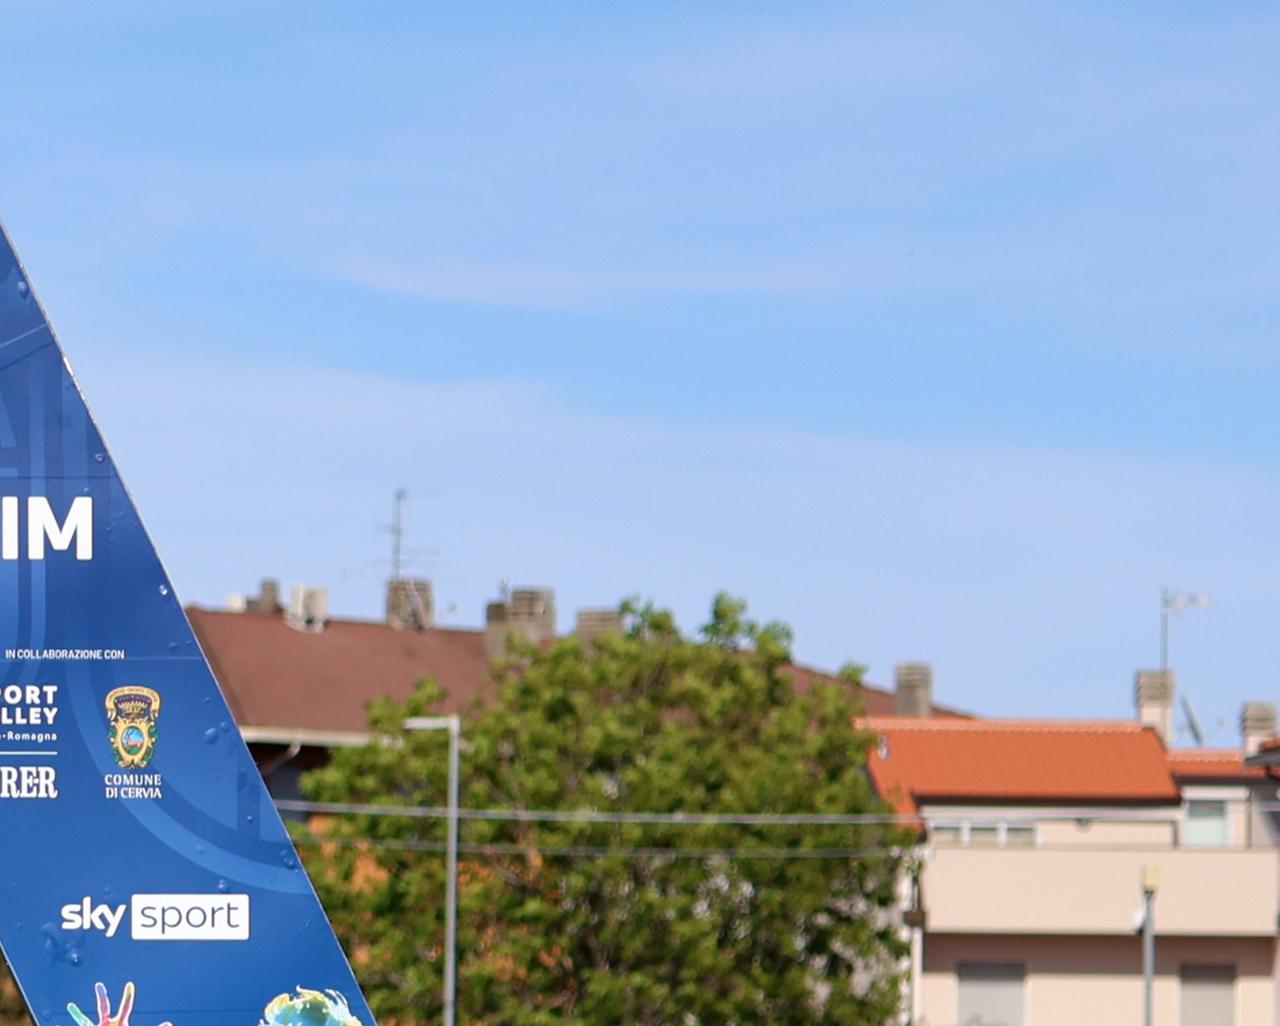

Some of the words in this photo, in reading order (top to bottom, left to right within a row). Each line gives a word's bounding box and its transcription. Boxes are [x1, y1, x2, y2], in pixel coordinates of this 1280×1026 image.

[5, 649, 16, 659] IN
[17, 649, 103, 660] COLLABORAZIONE
[104, 649, 125, 660] CON
[104, 774, 162, 786] COMUNE
[105, 787, 118, 799] DI
[120, 787, 162, 799] CERVIA
[61, 895, 127, 938] sky
[140, 902, 240, 935] sport
